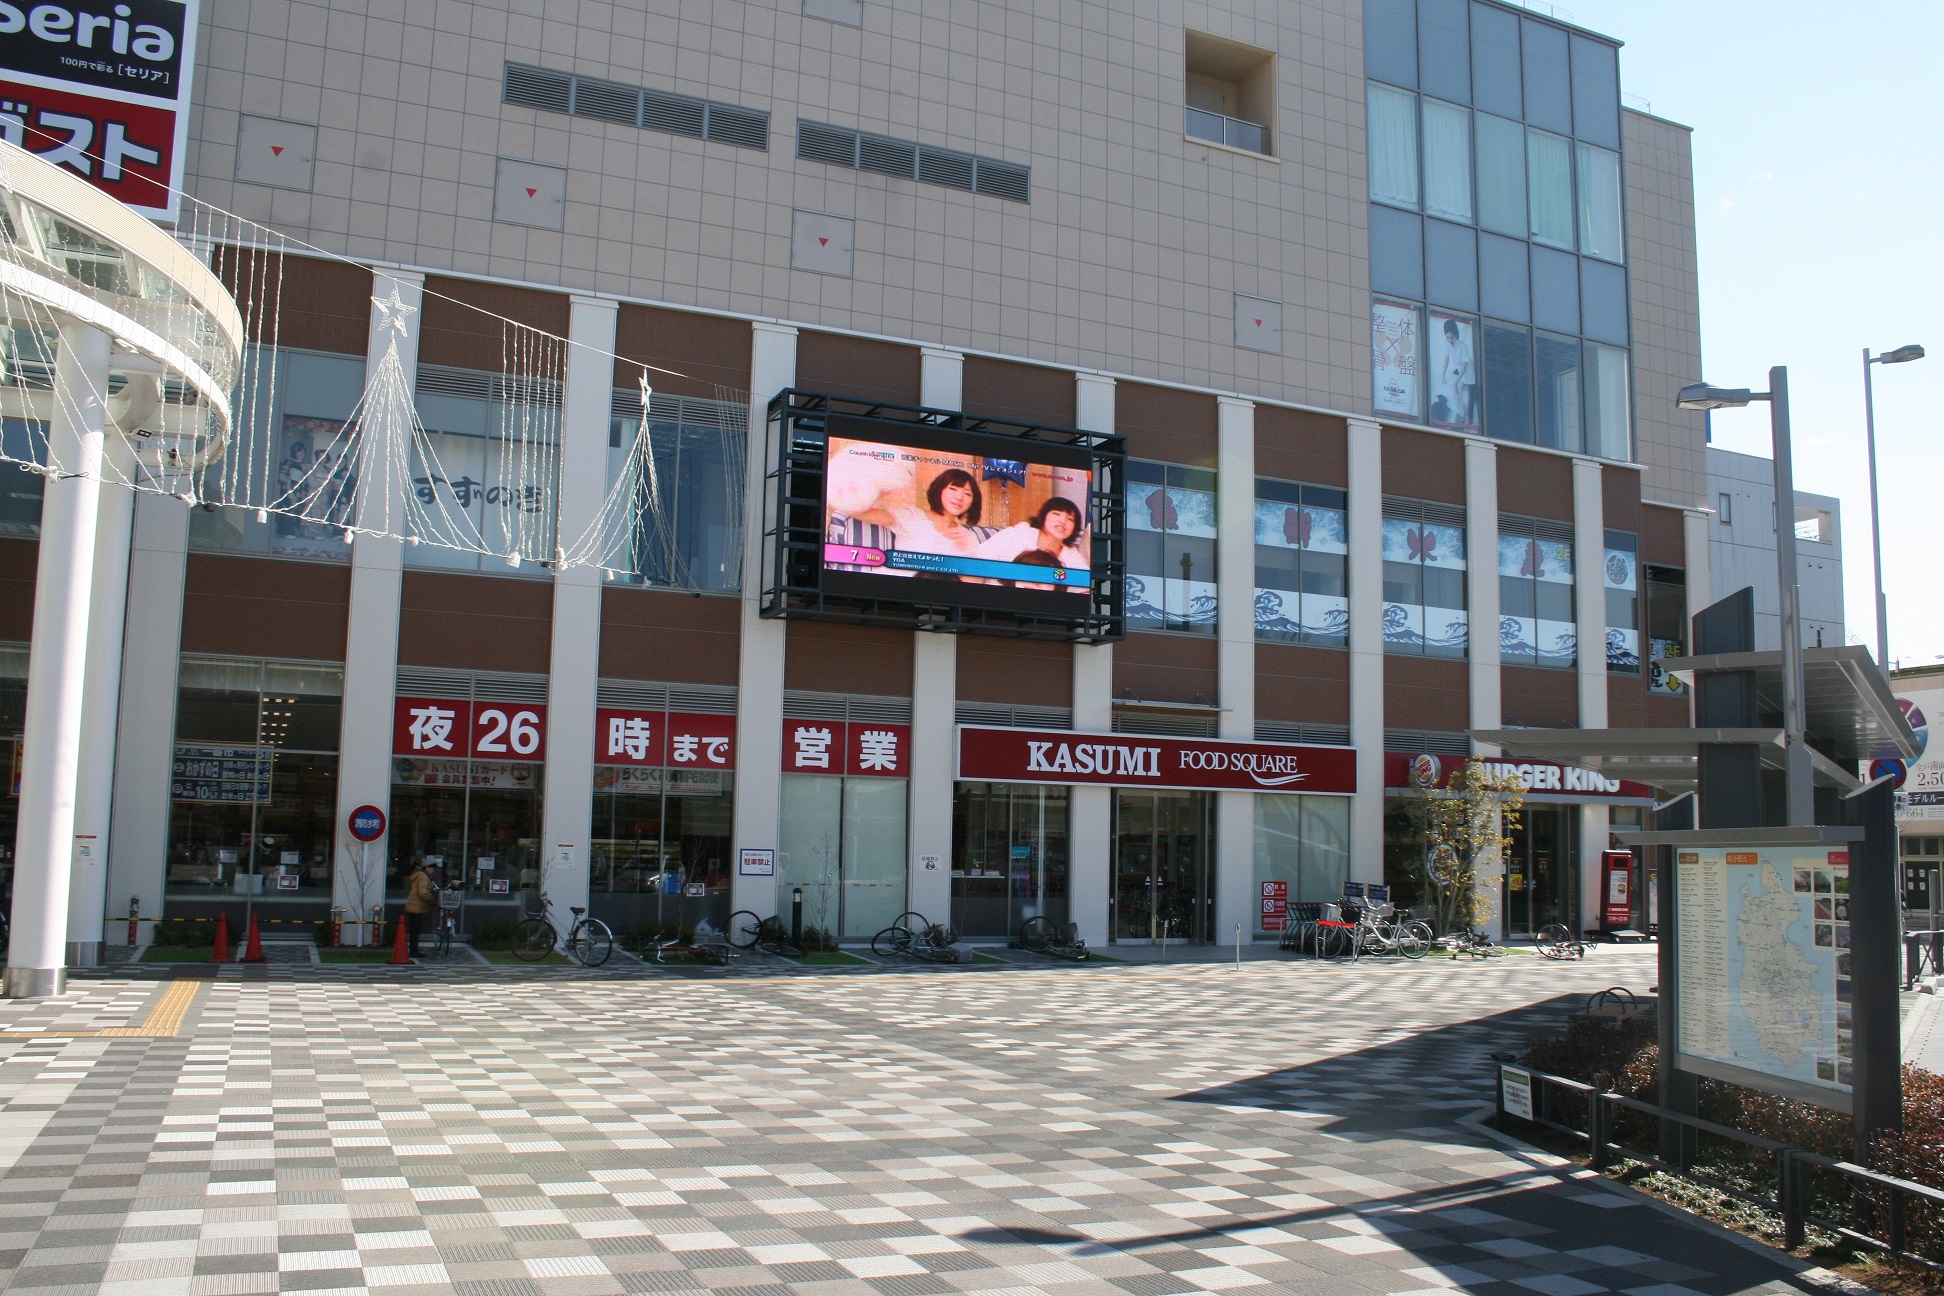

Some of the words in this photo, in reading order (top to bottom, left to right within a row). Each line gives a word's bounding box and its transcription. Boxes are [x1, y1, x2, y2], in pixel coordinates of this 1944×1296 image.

[850, 549, 858, 560] 7
[866, 553, 881, 561] New
[1027, 741, 1161, 777] KASUMI
[1179, 750, 1229, 770] FOOD
[1231, 753, 1300, 776] SQUARE
[743, 858, 771, 866] 駐車禁止
